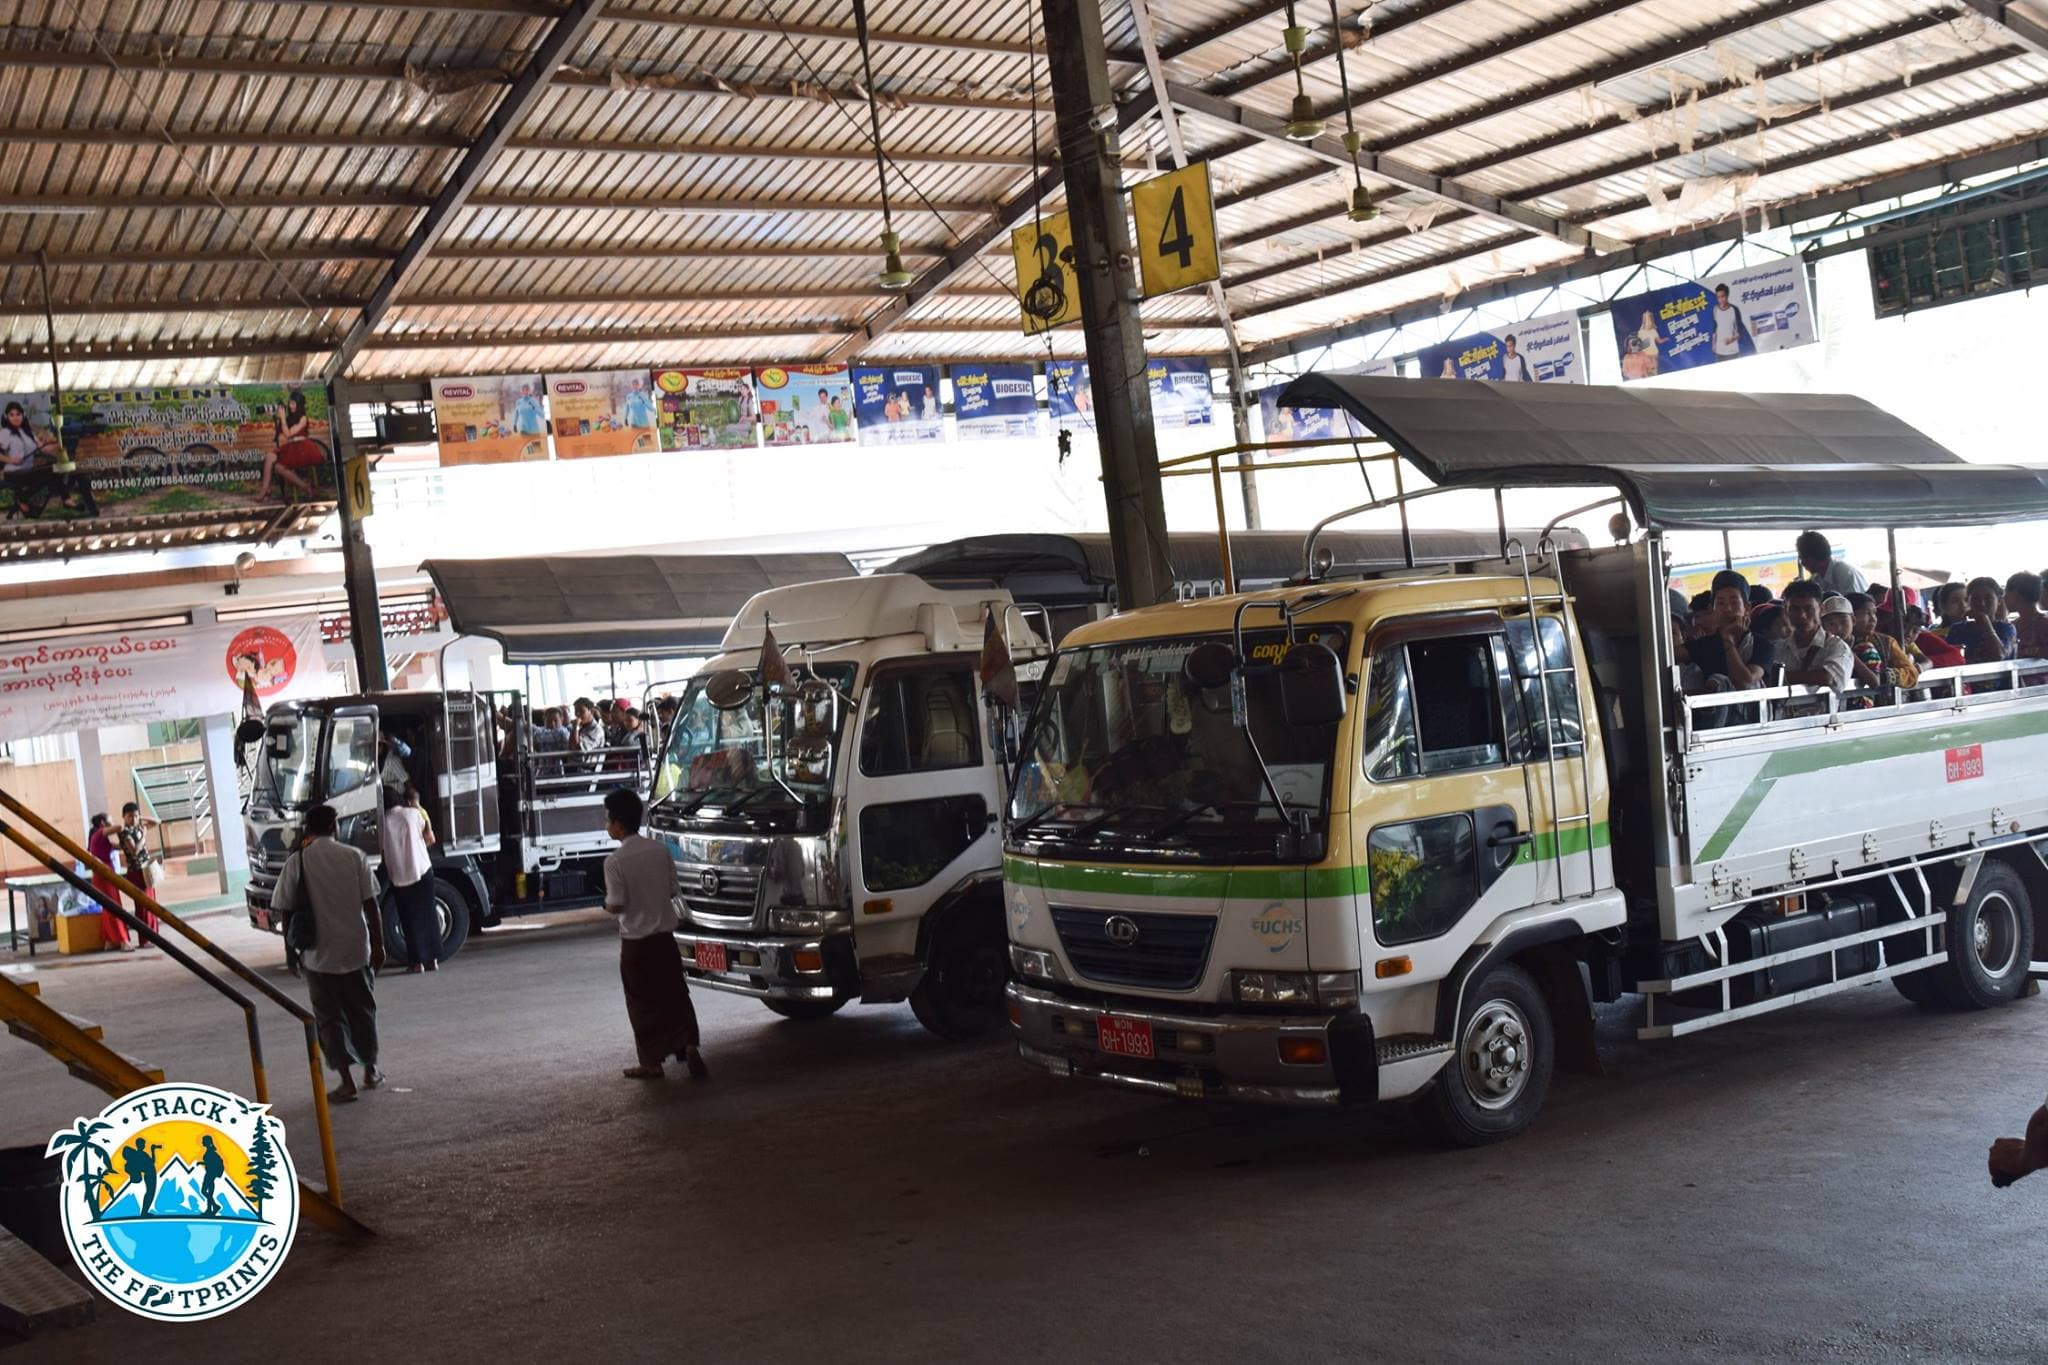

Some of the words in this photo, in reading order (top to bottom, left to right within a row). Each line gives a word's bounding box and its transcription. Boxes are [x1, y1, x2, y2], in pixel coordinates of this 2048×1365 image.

[1159, 186, 1194, 268] 4
[895, 374, 922, 384] BIOGESIC
[443, 387, 472, 399] REVITAL
[556, 383, 585, 394] REVITAL
[994, 382, 1032, 394] BIOGESIC
[353, 463, 366, 510] 6
[1948, 758, 1983, 780] 6H-1993
[1251, 917, 1303, 934] FUCHS
[1114, 1019, 1133, 1030] MON
[1102, 1028, 1151, 1055] 6H-1993
